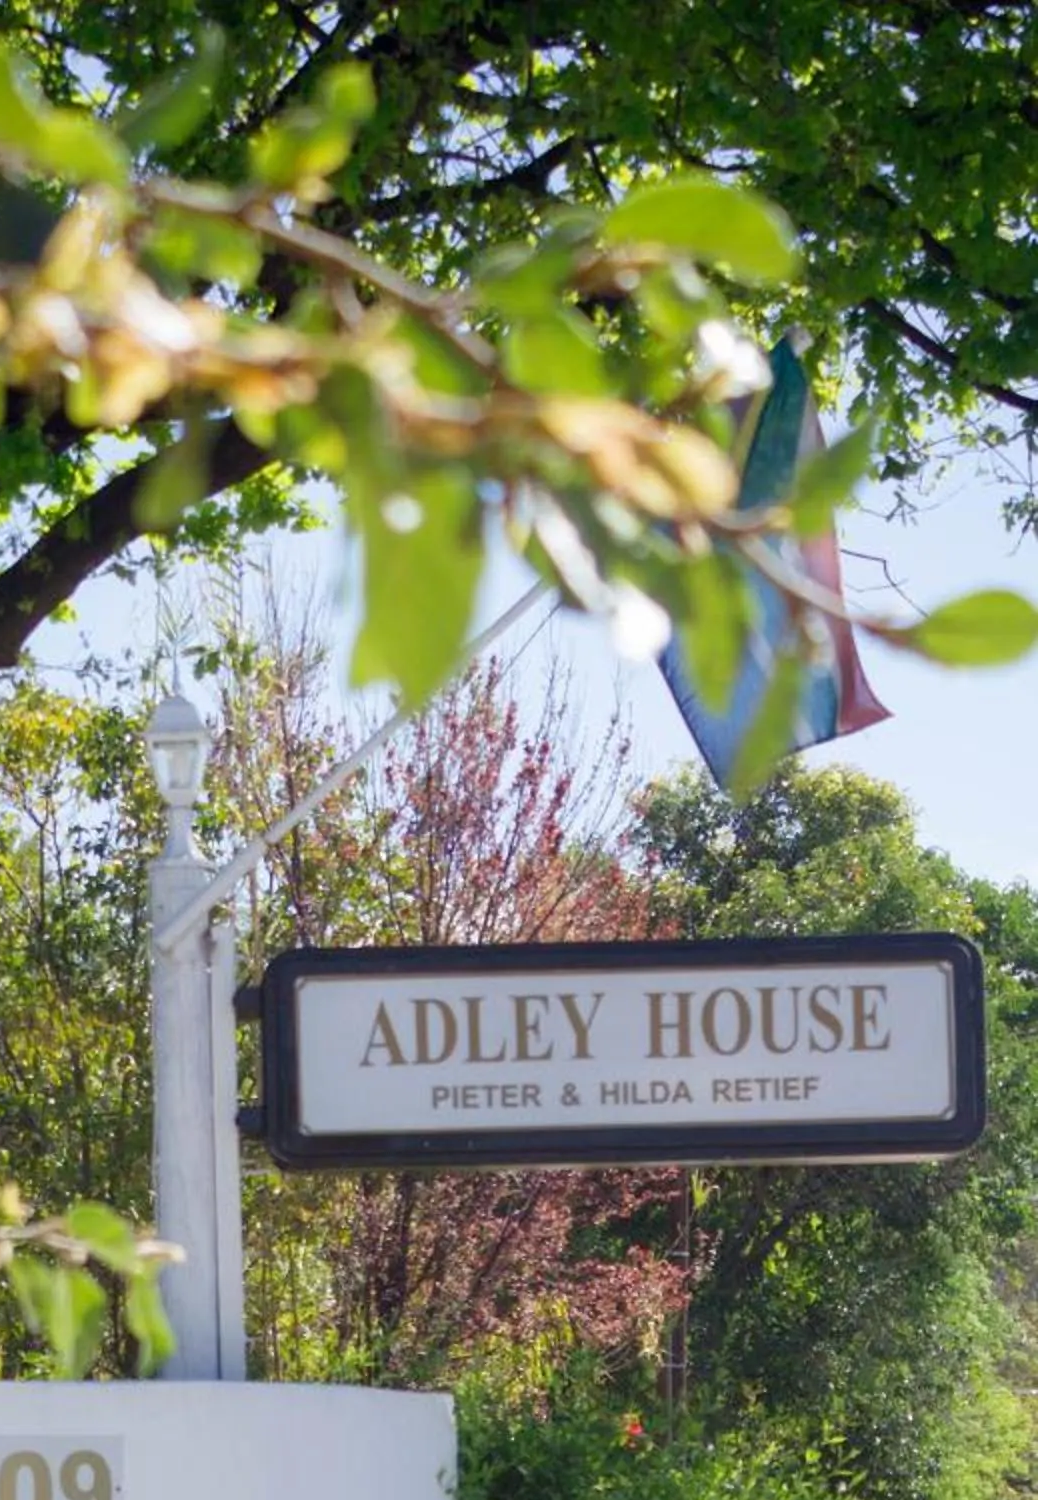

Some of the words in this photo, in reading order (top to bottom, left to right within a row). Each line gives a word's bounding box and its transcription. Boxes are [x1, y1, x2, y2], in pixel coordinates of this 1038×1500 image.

[359, 992, 605, 1067] ADLEY
[643, 984, 892, 1059] HOUSE
[430, 1084, 543, 1110] PIETER
[560, 1083, 582, 1107] &
[599, 1079, 693, 1106] HILDA
[710, 1076, 821, 1102] RETIEF
